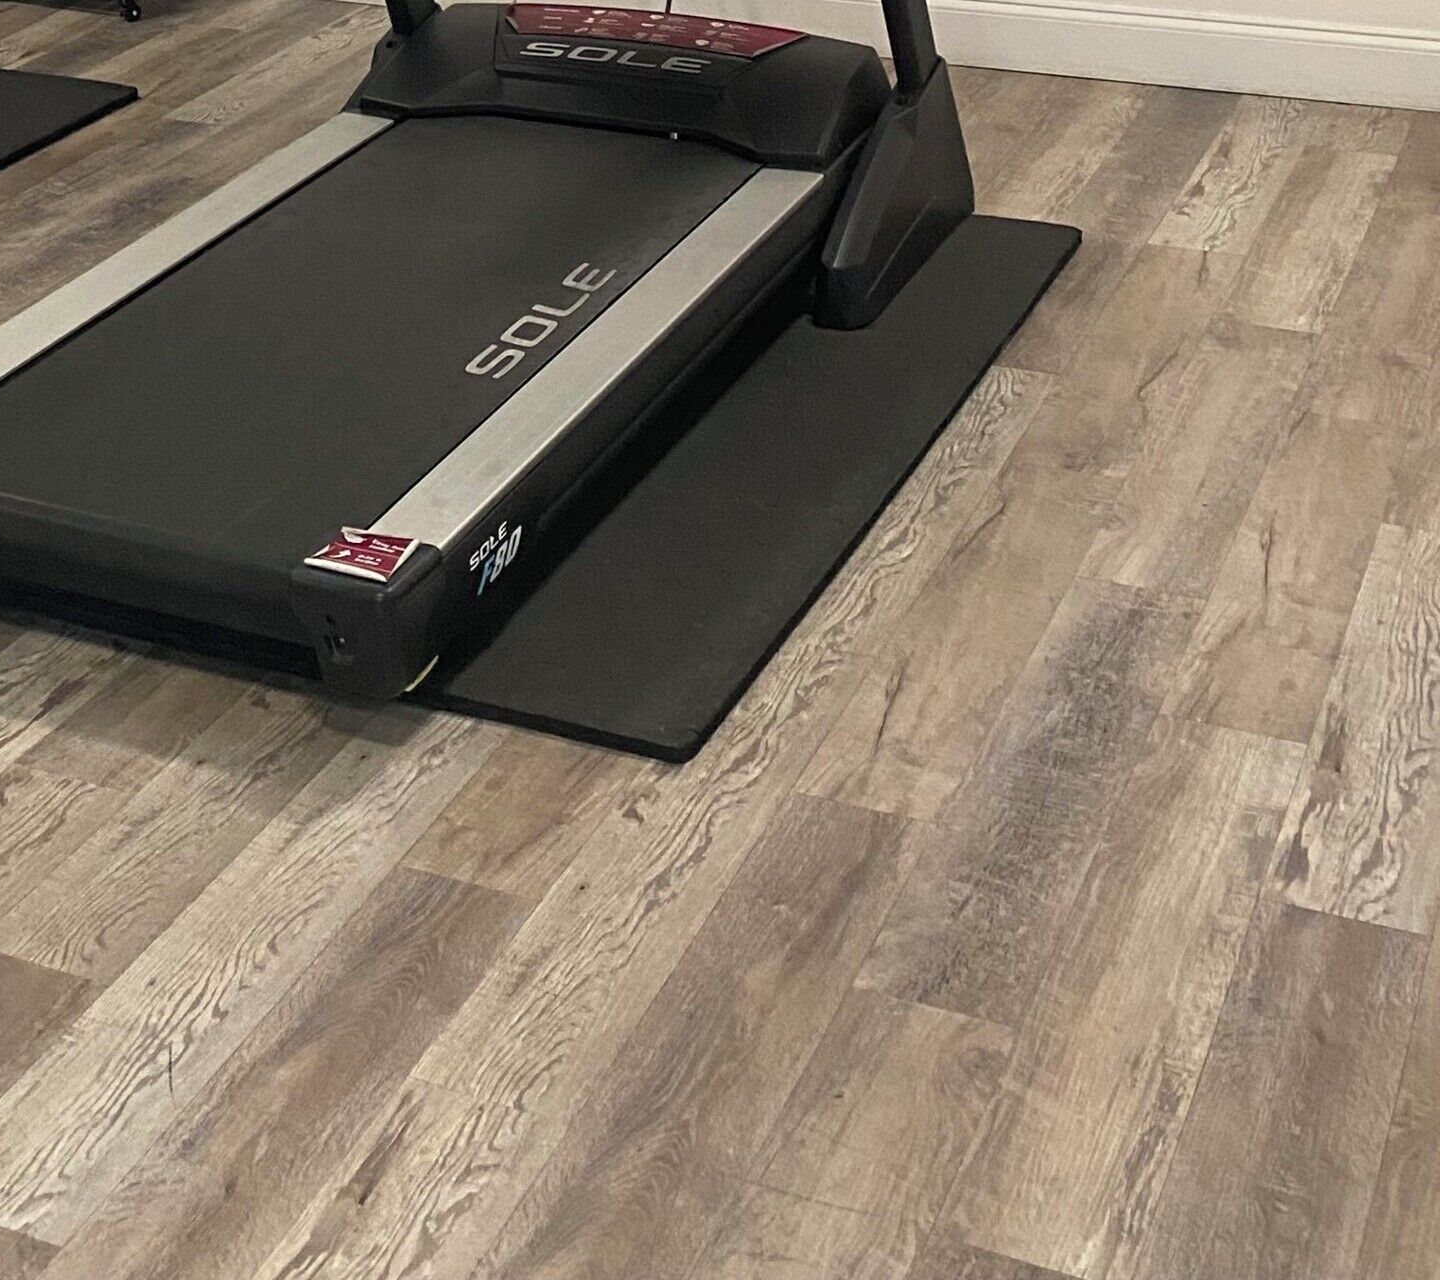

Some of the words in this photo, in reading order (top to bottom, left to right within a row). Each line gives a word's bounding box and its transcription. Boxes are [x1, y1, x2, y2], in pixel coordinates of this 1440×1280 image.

[520, 42, 711, 75] SOLE
[465, 262, 617, 379] SOLE
[469, 520, 508, 572] SOLE
[477, 525, 523, 596] F80
